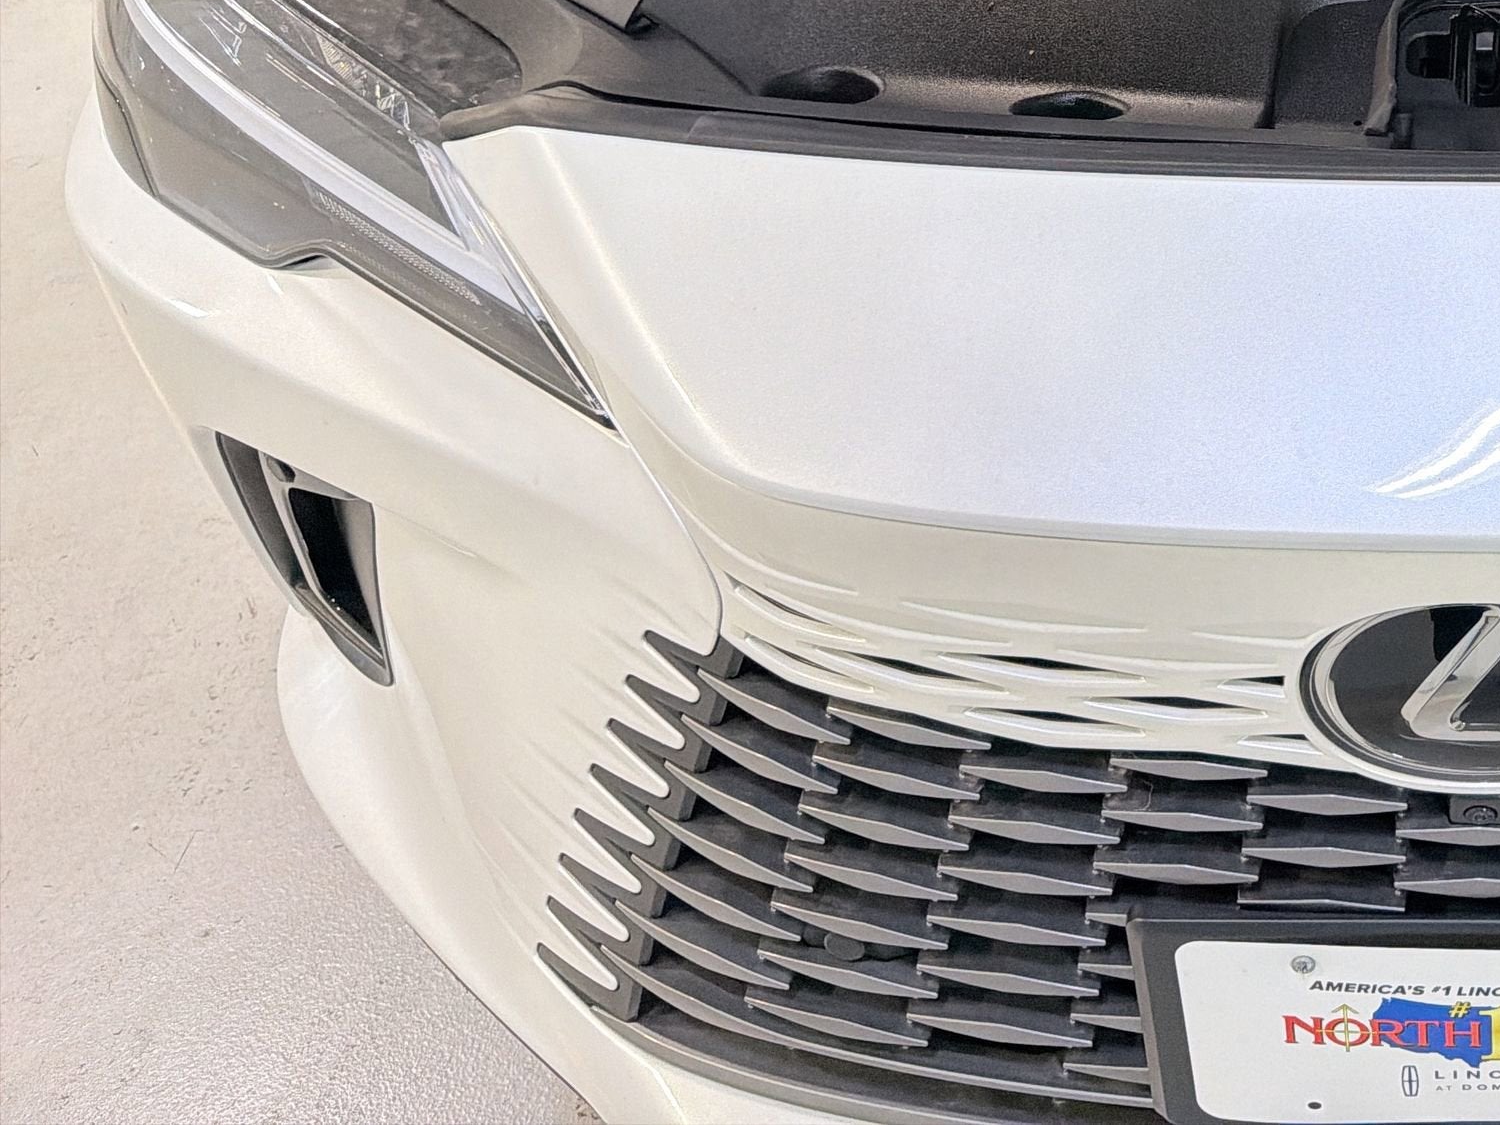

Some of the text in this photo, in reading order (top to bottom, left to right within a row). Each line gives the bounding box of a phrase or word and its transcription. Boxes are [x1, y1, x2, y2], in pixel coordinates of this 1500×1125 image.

[1309, 980, 1425, 995] AMERICA'S
[1431, 985, 1452, 996] #1
[1282, 1014, 1482, 1049] NORTH
[1435, 1084, 1452, 1092] AT
